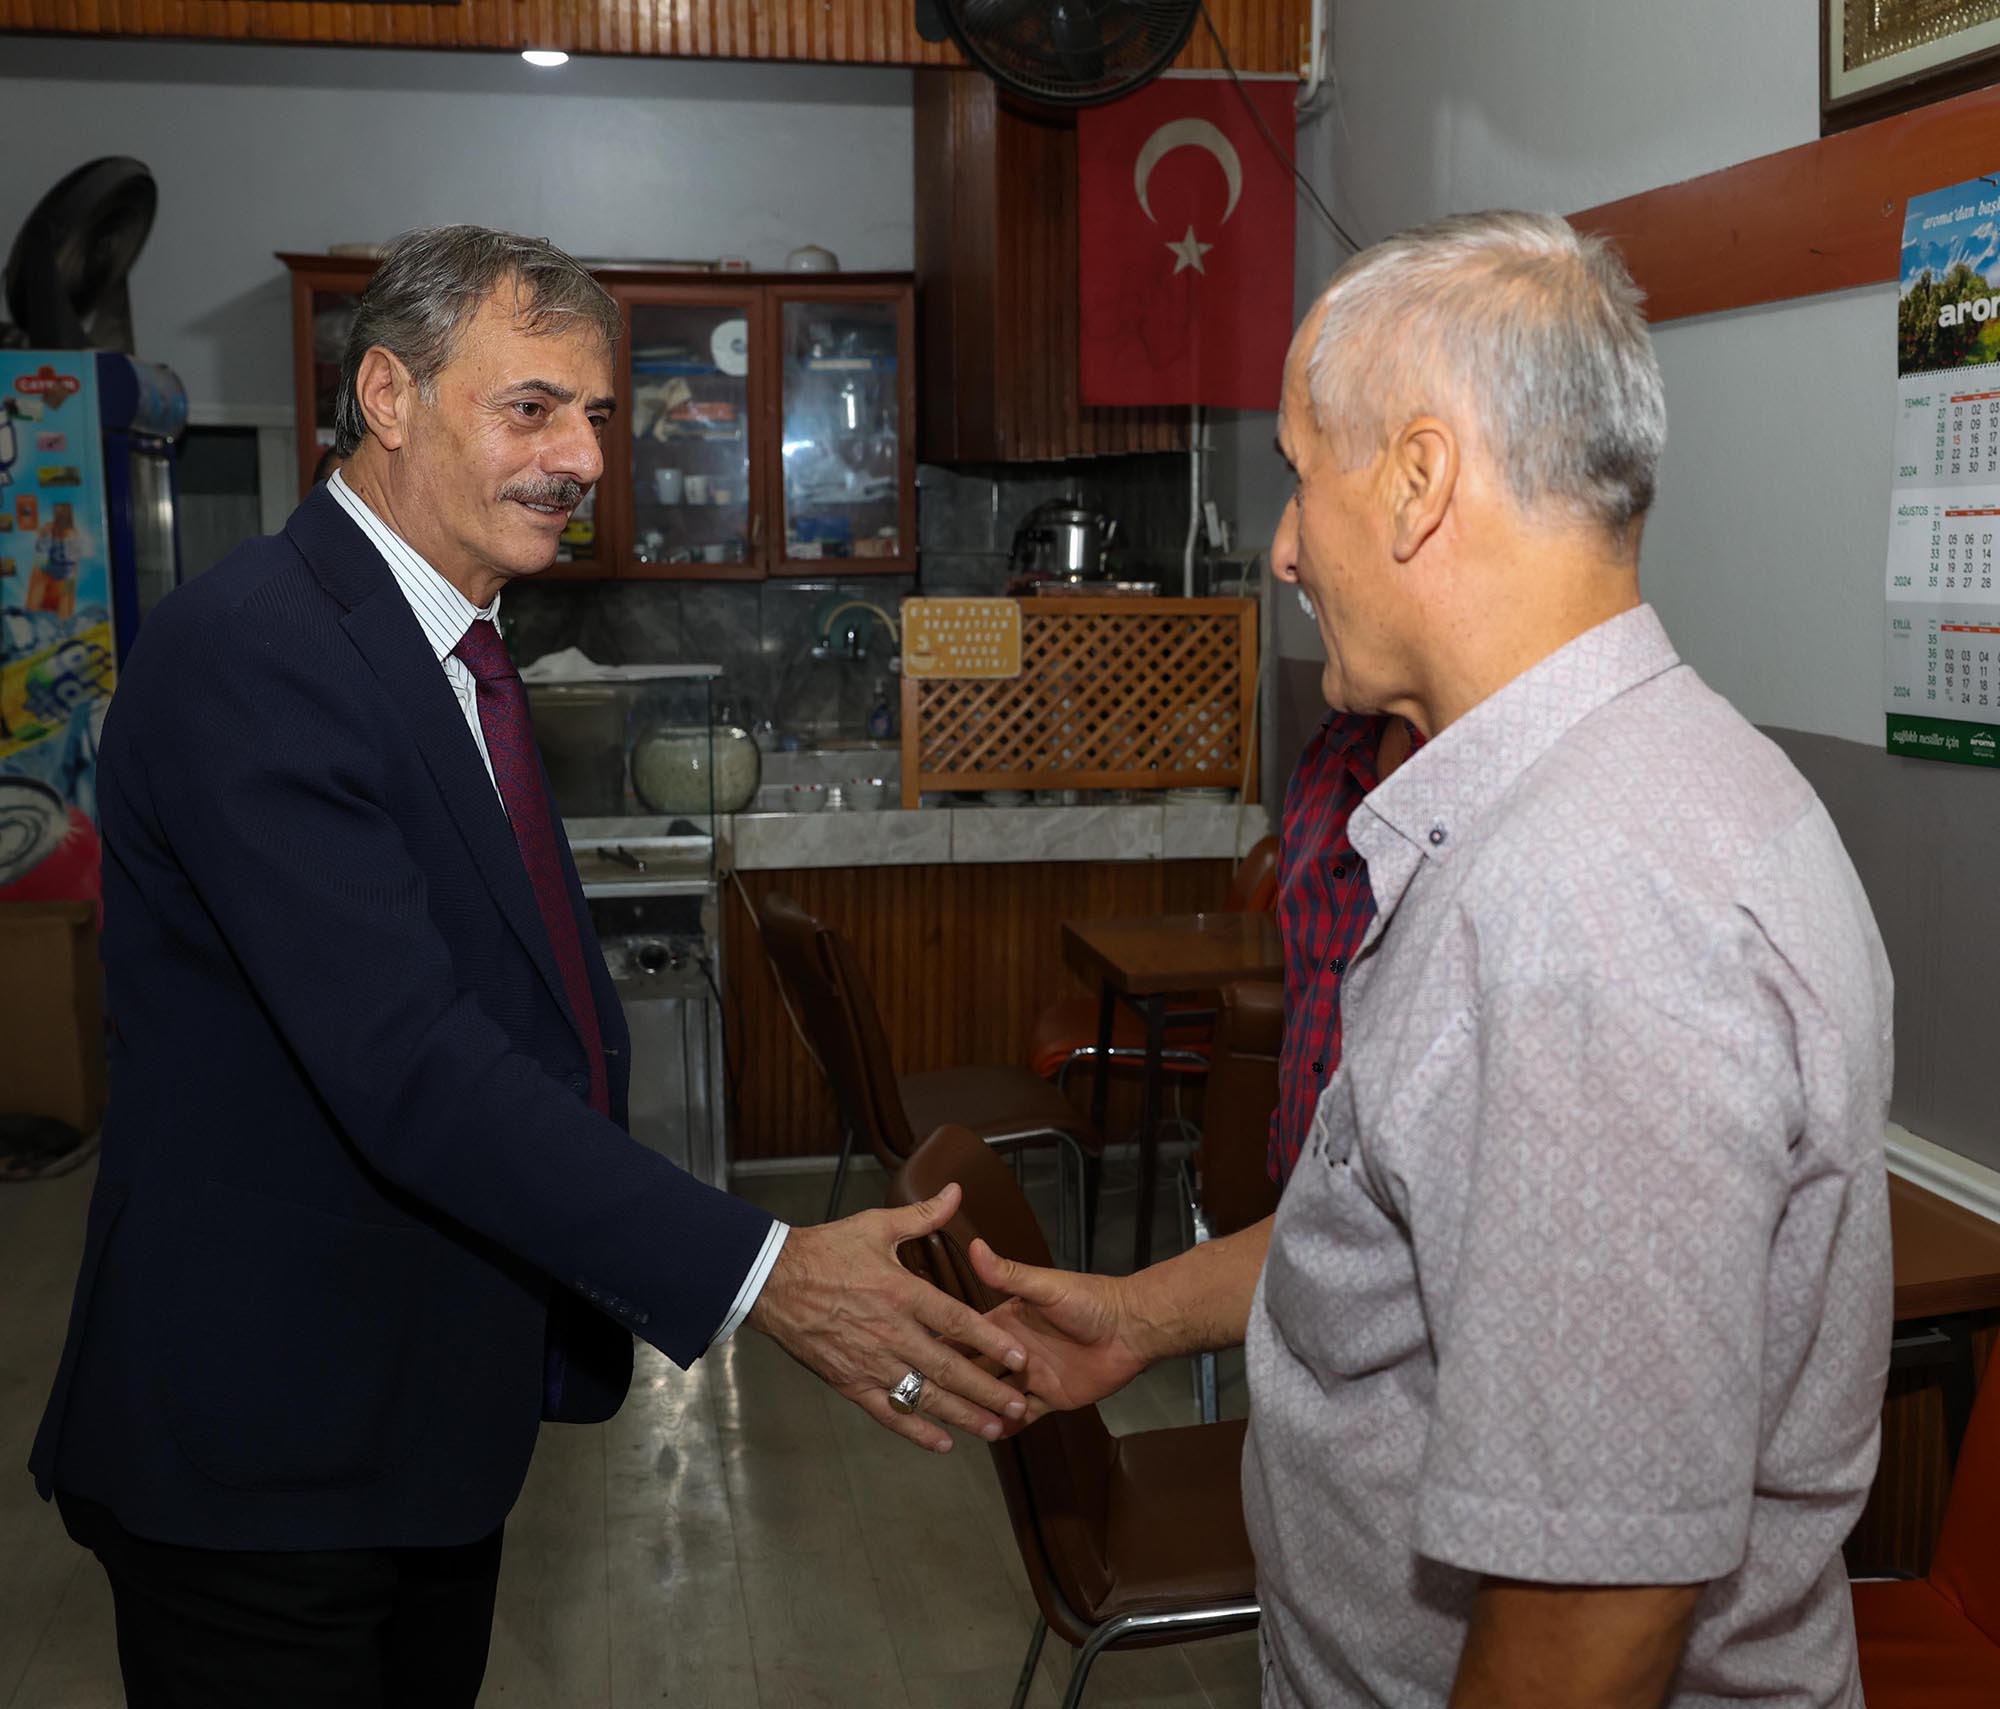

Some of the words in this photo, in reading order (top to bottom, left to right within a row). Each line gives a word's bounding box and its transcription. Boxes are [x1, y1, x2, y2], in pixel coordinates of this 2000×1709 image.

[1954, 406, 1962, 417] 01
[1971, 404, 1981, 415] 02
[1990, 402, 2000, 414] 03
[1970, 419, 1980, 430] 09
[1990, 417, 1998, 428] 10
[1970, 433, 1979, 444] 16
[1990, 432, 1998, 442] 17
[1952, 448, 1960, 460] 22
[1970, 447, 1979, 458] 23
[1988, 446, 1998, 456] 24
[1952, 462, 1960, 474] 29
[1968, 462, 1978, 472] 30
[1988, 461, 1996, 472] 31
[1948, 534, 1958, 545] 05
[1965, 534, 1974, 545] 06
[1982, 534, 1992, 545] 07
[1949, 548, 1956, 560] 12
[1966, 548, 1973, 560] 13
[1982, 548, 1992, 558] 14
[1948, 562, 1956, 573] 19
[1964, 562, 1973, 574] 20
[1982, 562, 1991, 574] 21
[1946, 577, 1955, 588] 26
[1963, 577, 1972, 588] 27
[1981, 577, 1992, 588] 28
[1945, 648, 1954, 660] 02
[1961, 650, 1970, 662] 03
[1979, 651, 1989, 662] 04
[1945, 662, 1954, 674] 09
[1962, 664, 1970, 675] 10
[1980, 666, 1988, 676] 11
[1946, 676, 1953, 687] 16
[1962, 678, 1970, 689] 17
[1980, 680, 1988, 691] 18
[1961, 693, 1970, 704] 24
[1979, 694, 1988, 706] 25
